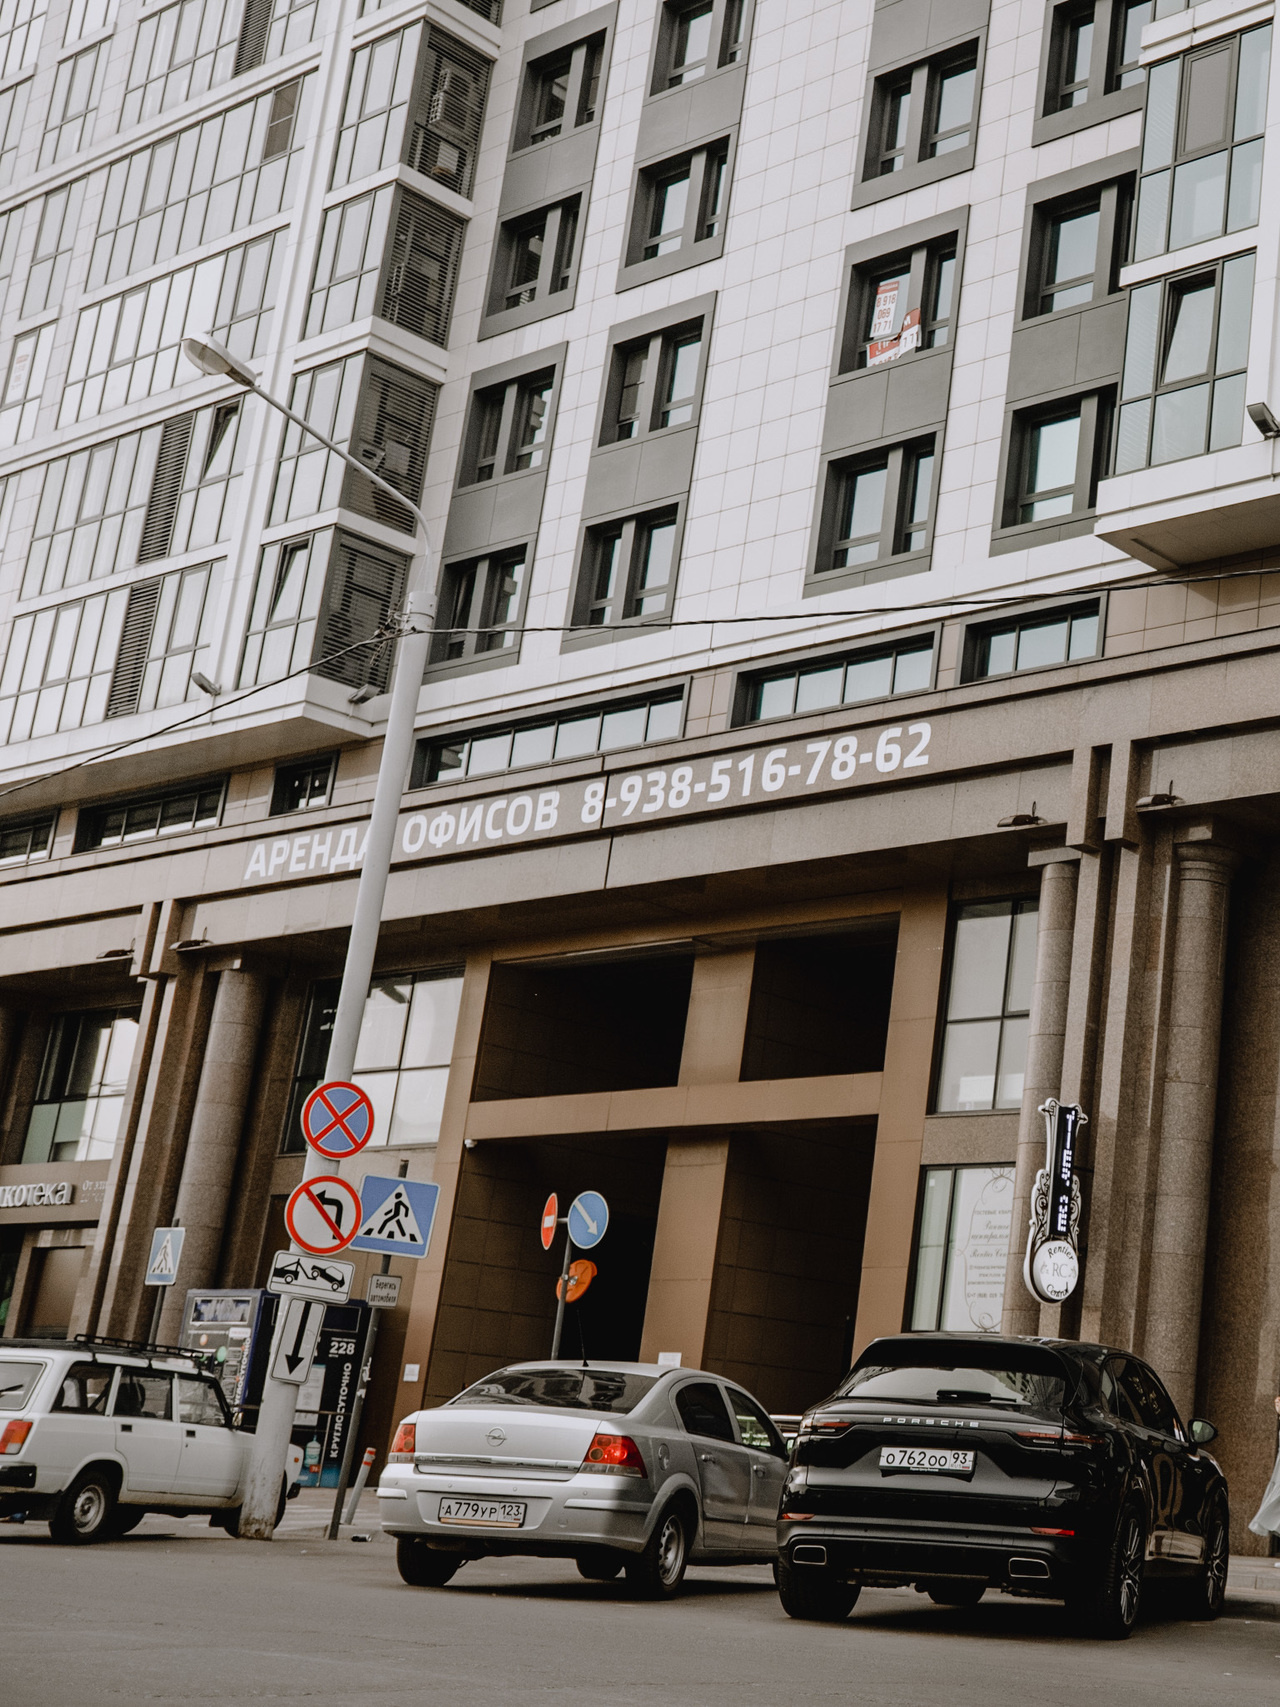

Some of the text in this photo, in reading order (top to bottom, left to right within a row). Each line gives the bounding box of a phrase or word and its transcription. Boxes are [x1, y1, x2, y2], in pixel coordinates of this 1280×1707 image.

[882, 294, 897, 306] 918
[402, 791, 560, 854] ОФИСОВ
[580, 722, 932, 824] 8-938-516-78-62
[0, 1182, 72, 1207] котека
[1047, 1246, 1074, 1260] Rentier
[1046, 1281, 1069, 1297] Central
[329, 1341, 356, 1355] 228
[330, 1362, 352, 1458] КРУГЛОСУТОЧНО
[883, 1417, 979, 1428] PORSCHE
[952, 1452, 968, 1464] 93
[500, 1504, 521, 1517] 123
